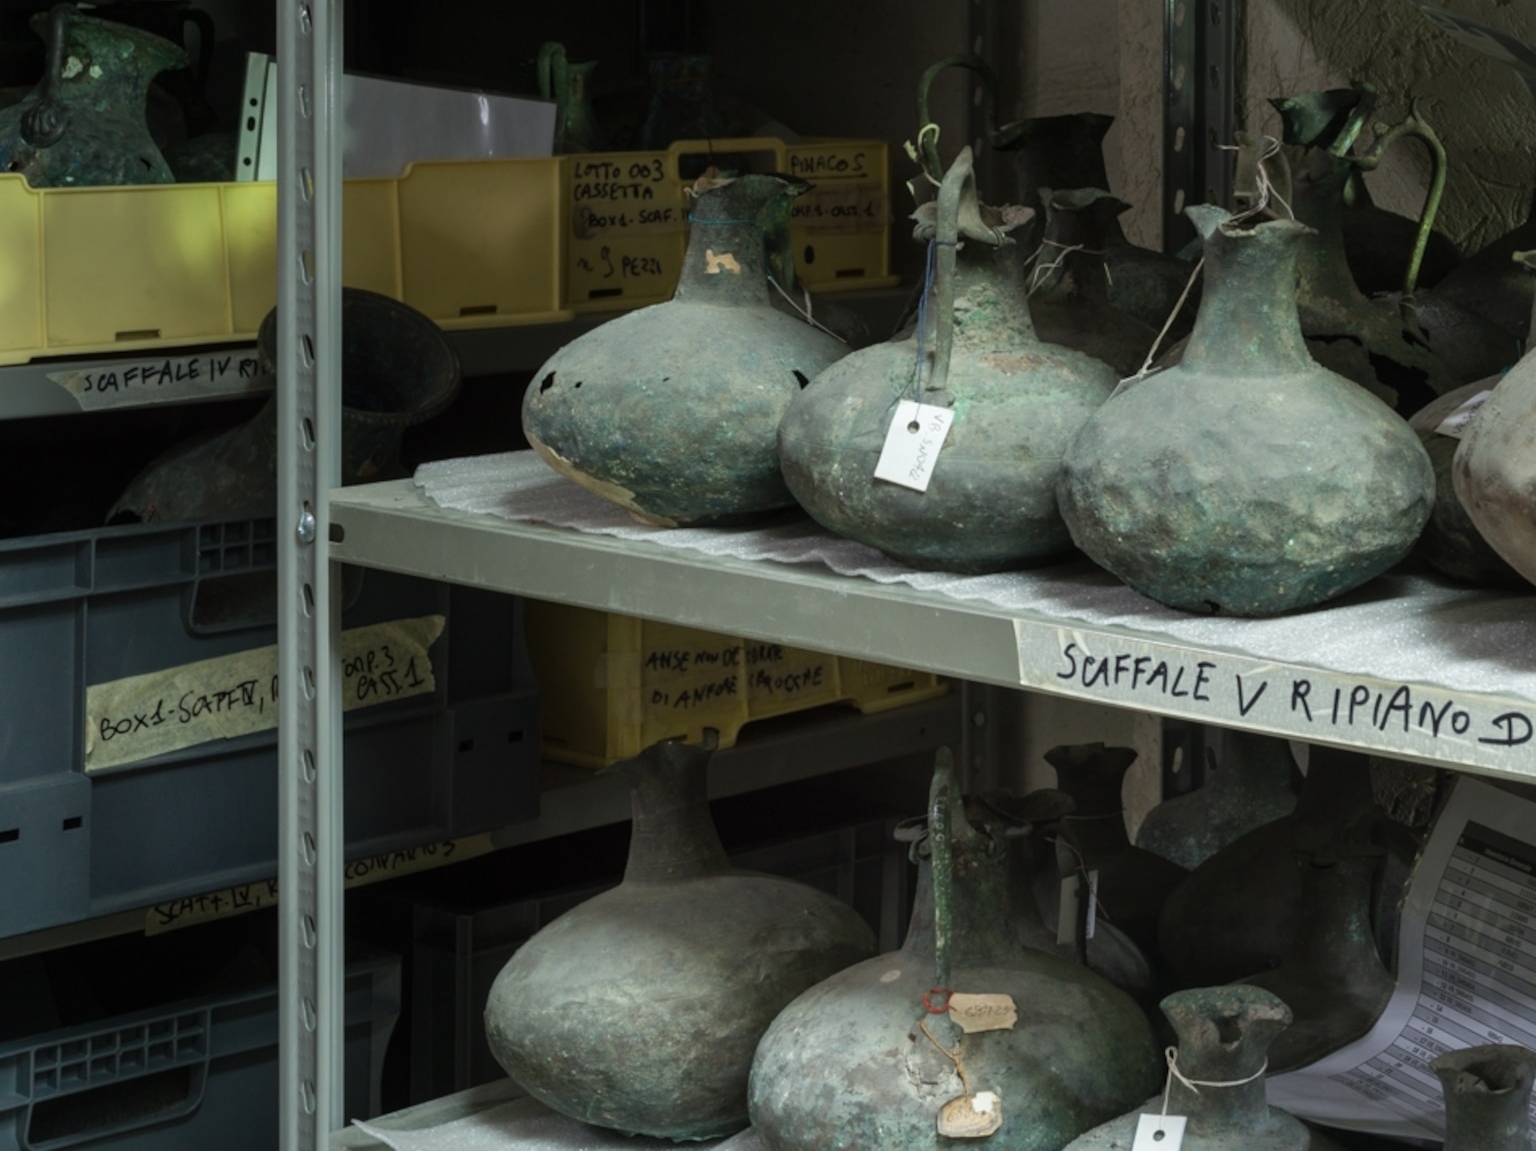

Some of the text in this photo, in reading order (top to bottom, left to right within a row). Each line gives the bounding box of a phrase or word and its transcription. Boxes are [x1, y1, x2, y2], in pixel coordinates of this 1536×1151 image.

[575, 159, 664, 181] LOTTO 003
[573, 183, 653, 200] CASSETTA
[84, 359, 200, 392] SCAFFALE
[211, 356, 231, 381] IV
[1057, 643, 1533, 747] SCAFFALE V RIPIANO D
